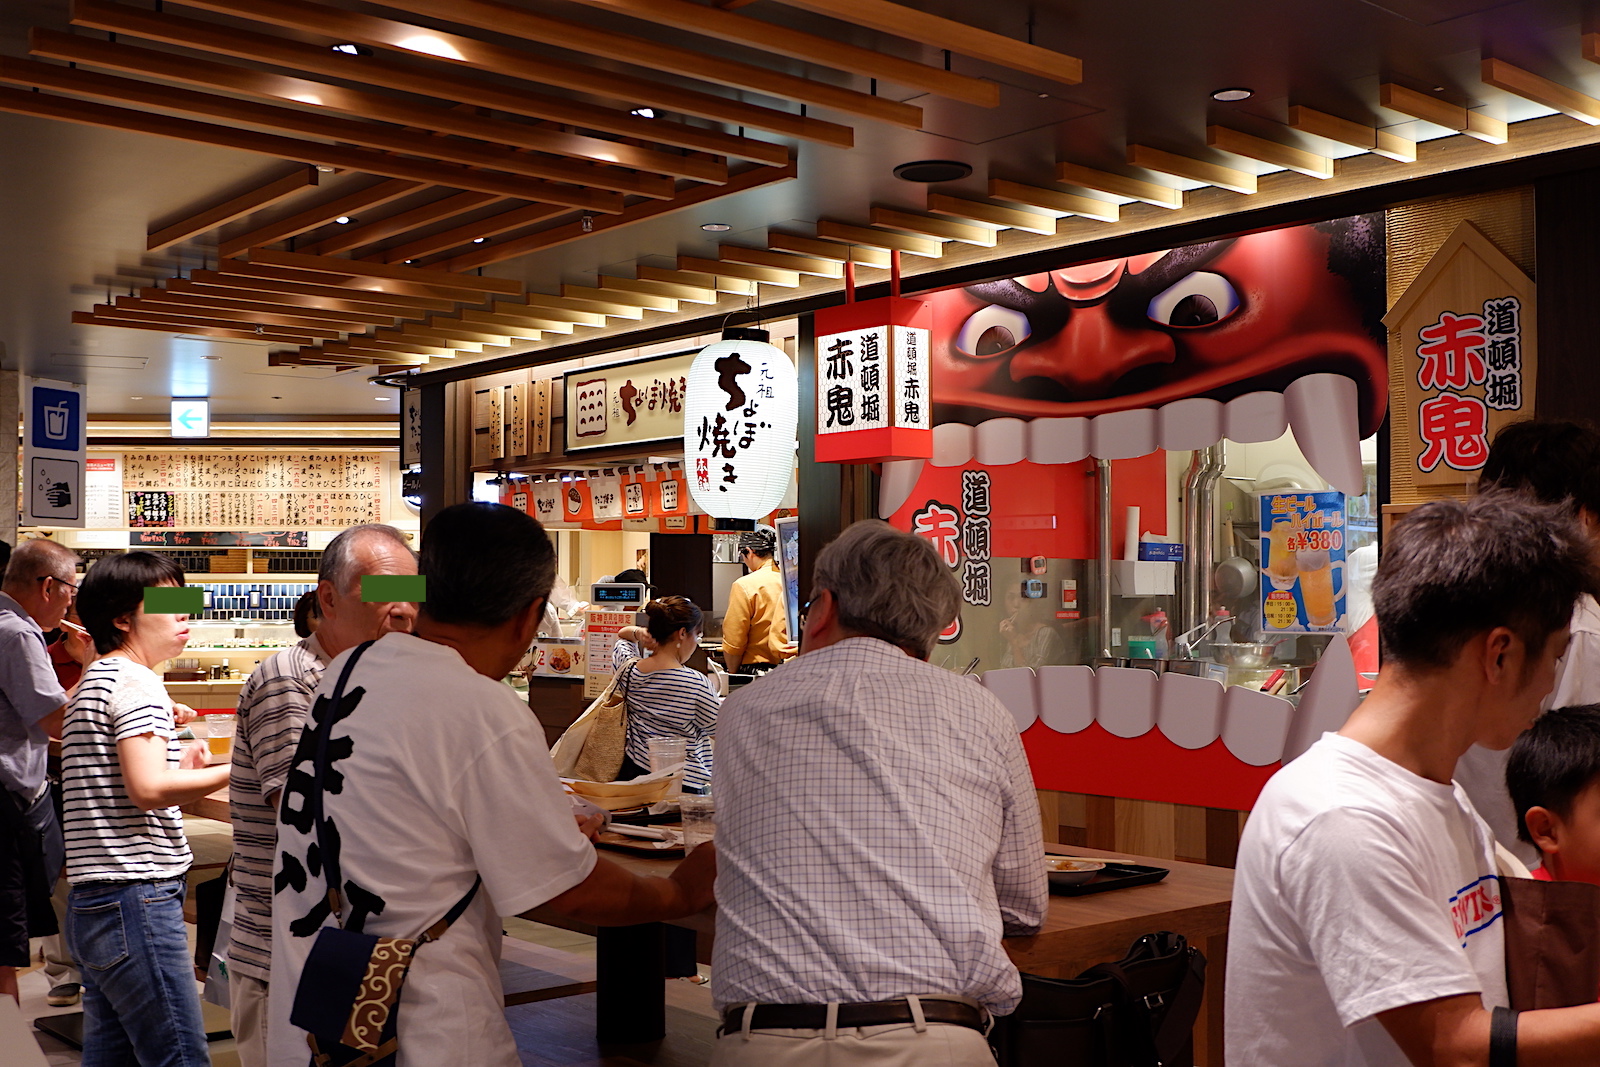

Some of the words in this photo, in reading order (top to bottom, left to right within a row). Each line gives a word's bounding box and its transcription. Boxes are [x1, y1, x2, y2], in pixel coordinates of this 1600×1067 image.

[1486, 299, 1519, 408] 道頓堀
[756, 362, 774, 398] 元祖
[826, 338, 855, 428] 赤鬼
[860, 332, 880, 422] 道頓堀
[1418, 314, 1489, 471] 赤鬼
[323, 454, 329, 487] えび
[367, 454, 373, 487] いか
[265, 493, 270, 525] うに
[1271, 496, 1317, 514] 生ビール
[1290, 510, 1345, 529] ハイボール
[962, 470, 991, 606] 道頓堀
